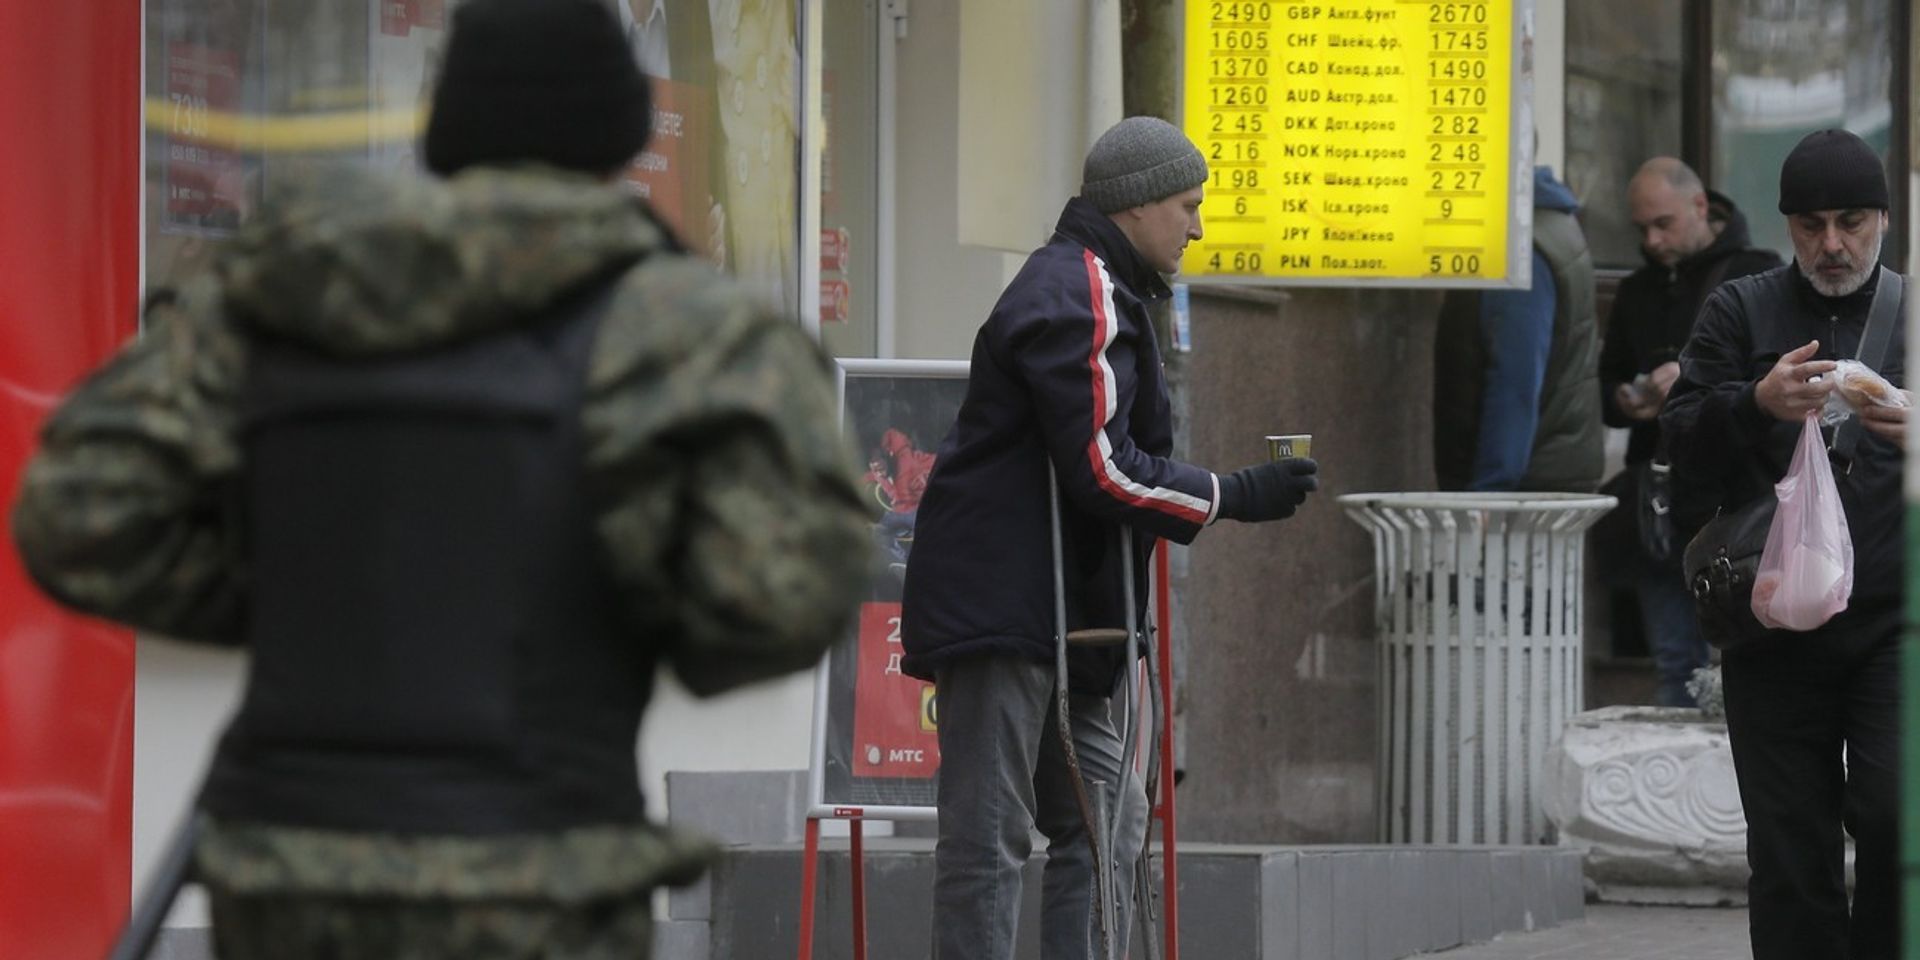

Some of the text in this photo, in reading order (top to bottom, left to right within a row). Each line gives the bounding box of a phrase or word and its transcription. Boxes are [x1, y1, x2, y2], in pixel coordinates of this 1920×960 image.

[1212, 2, 1271, 21] 2490
[1287, 6, 1321, 20] GBP
[1429, 3, 1486, 23] 2670
[1211, 30, 1267, 49] 1605
[1287, 33, 1318, 47] CHF
[1432, 31, 1487, 50] 1745
[1211, 58, 1267, 76] 1370
[1286, 61, 1319, 75] CAD
[1430, 60, 1485, 79] 1490
[1211, 86, 1267, 104] 1260
[1286, 89, 1320, 103] AUD
[1431, 87, 1486, 106] 1470
[1285, 116, 1318, 130] DKK
[1284, 144, 1319, 157] NOK
[1283, 171, 1312, 186] SEK
[1282, 198, 1308, 213] ISK
[1282, 227, 1310, 241] JPY
[1281, 254, 1311, 269] PLN
[886, 616, 901, 642] 2
[885, 653, 901, 675] Д
[889, 750, 924, 763] МТС
